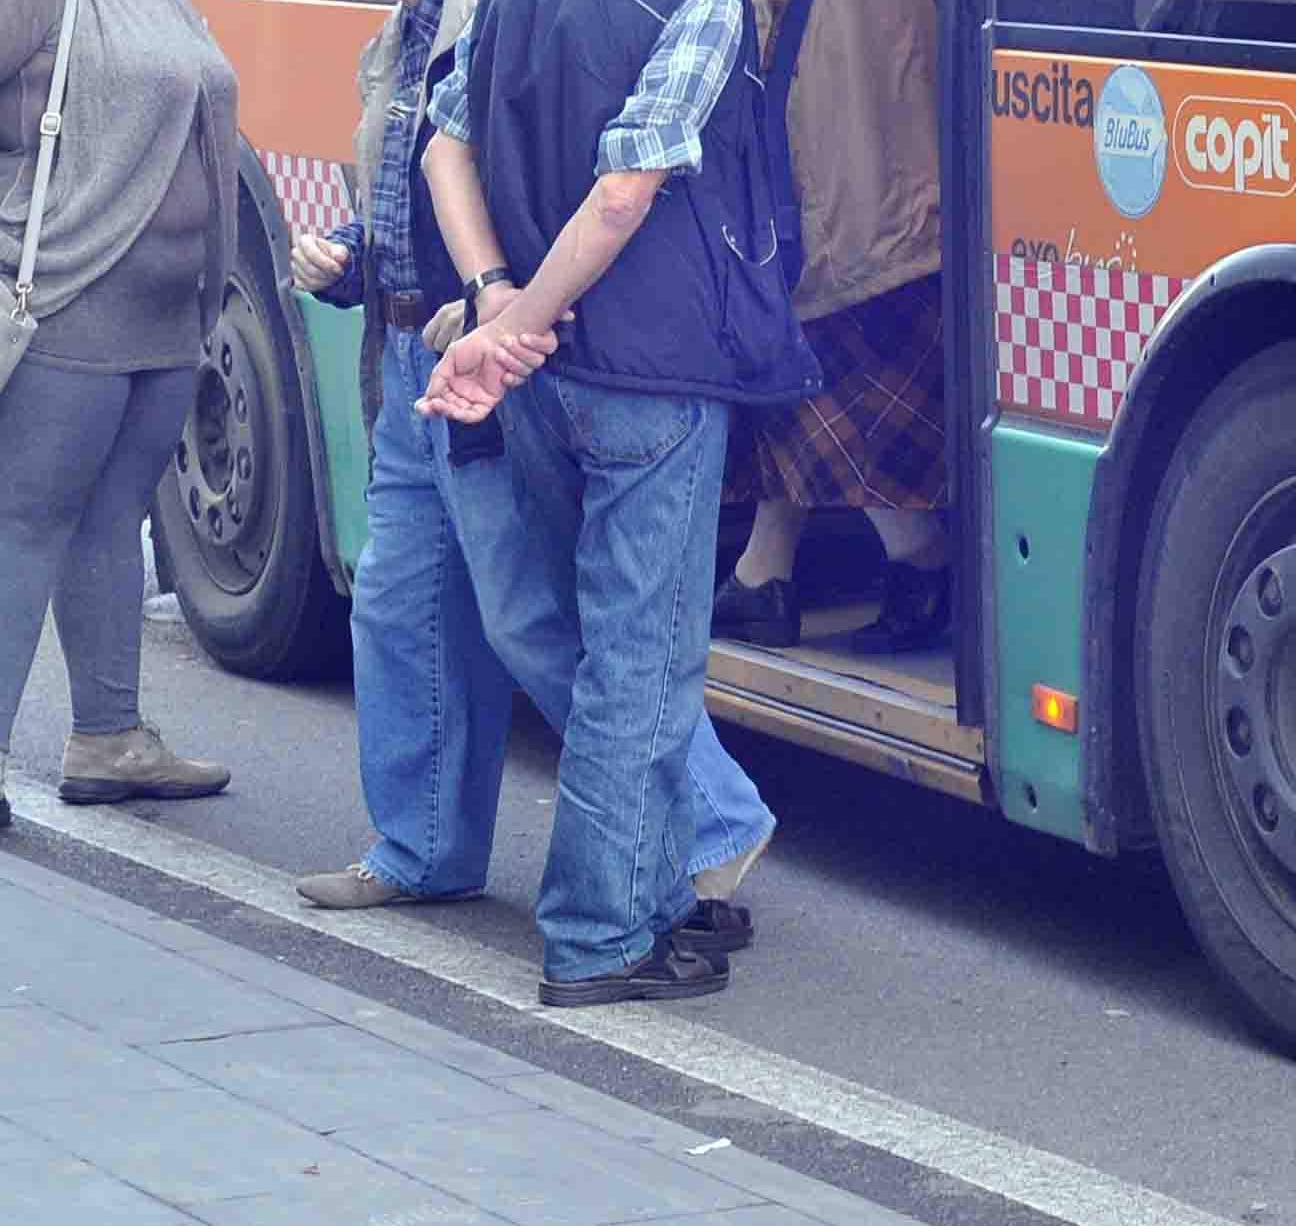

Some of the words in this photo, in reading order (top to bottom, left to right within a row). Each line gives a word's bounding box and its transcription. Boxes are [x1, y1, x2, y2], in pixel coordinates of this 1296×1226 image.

[991, 64, 1094, 127] uscita
[1104, 117, 1152, 151] BluBus
[1185, 112, 1290, 193] copit
